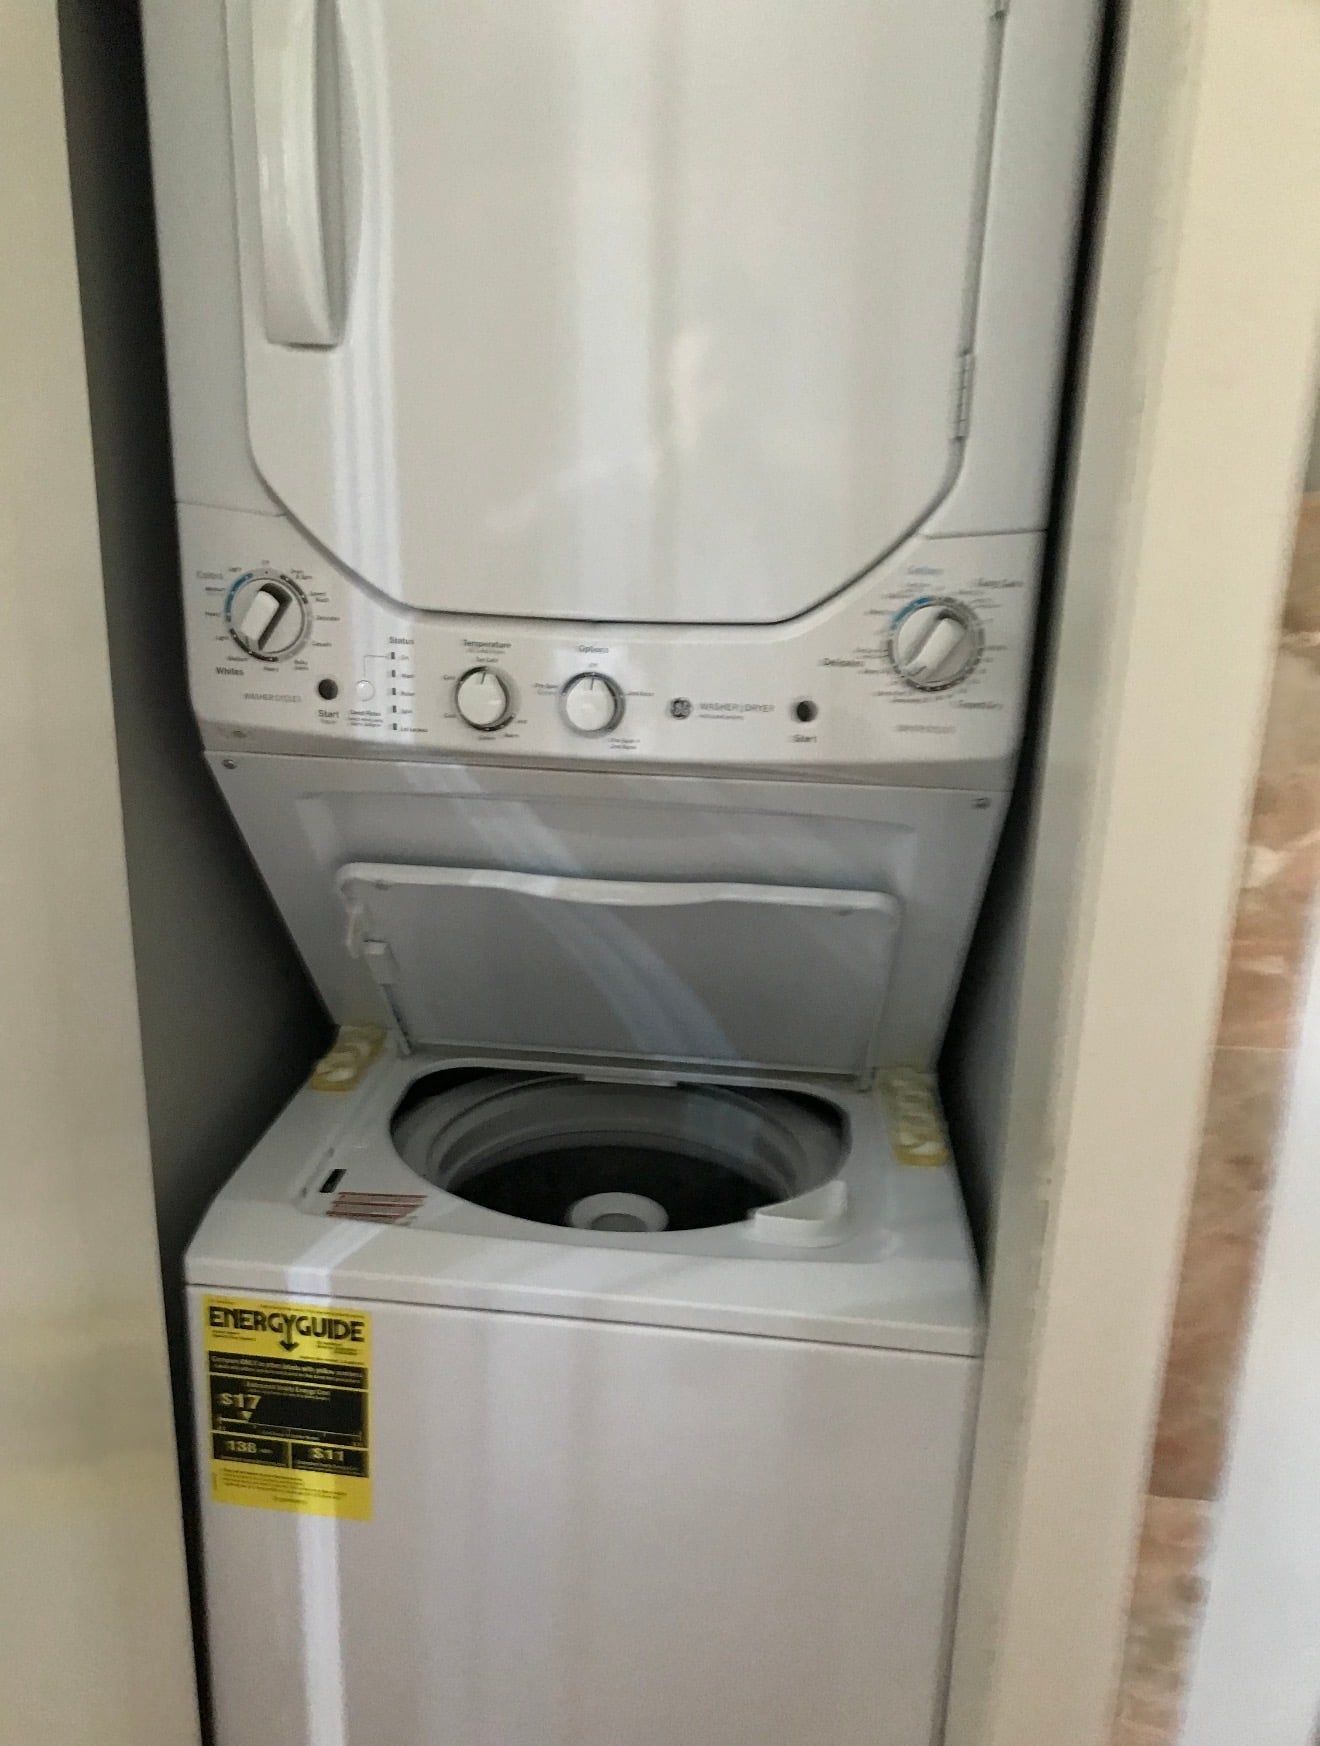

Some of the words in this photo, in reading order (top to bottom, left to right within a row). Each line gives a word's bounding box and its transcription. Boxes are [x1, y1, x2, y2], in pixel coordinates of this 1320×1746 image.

[389, 635, 415, 645] Status
[463, 639, 512, 650] Temperature
[578, 644, 609, 655] Options
[215, 666, 244, 677] Whites
[318, 708, 340, 719] Start
[208, 1306, 365, 1343] ENERGYGUIDE
